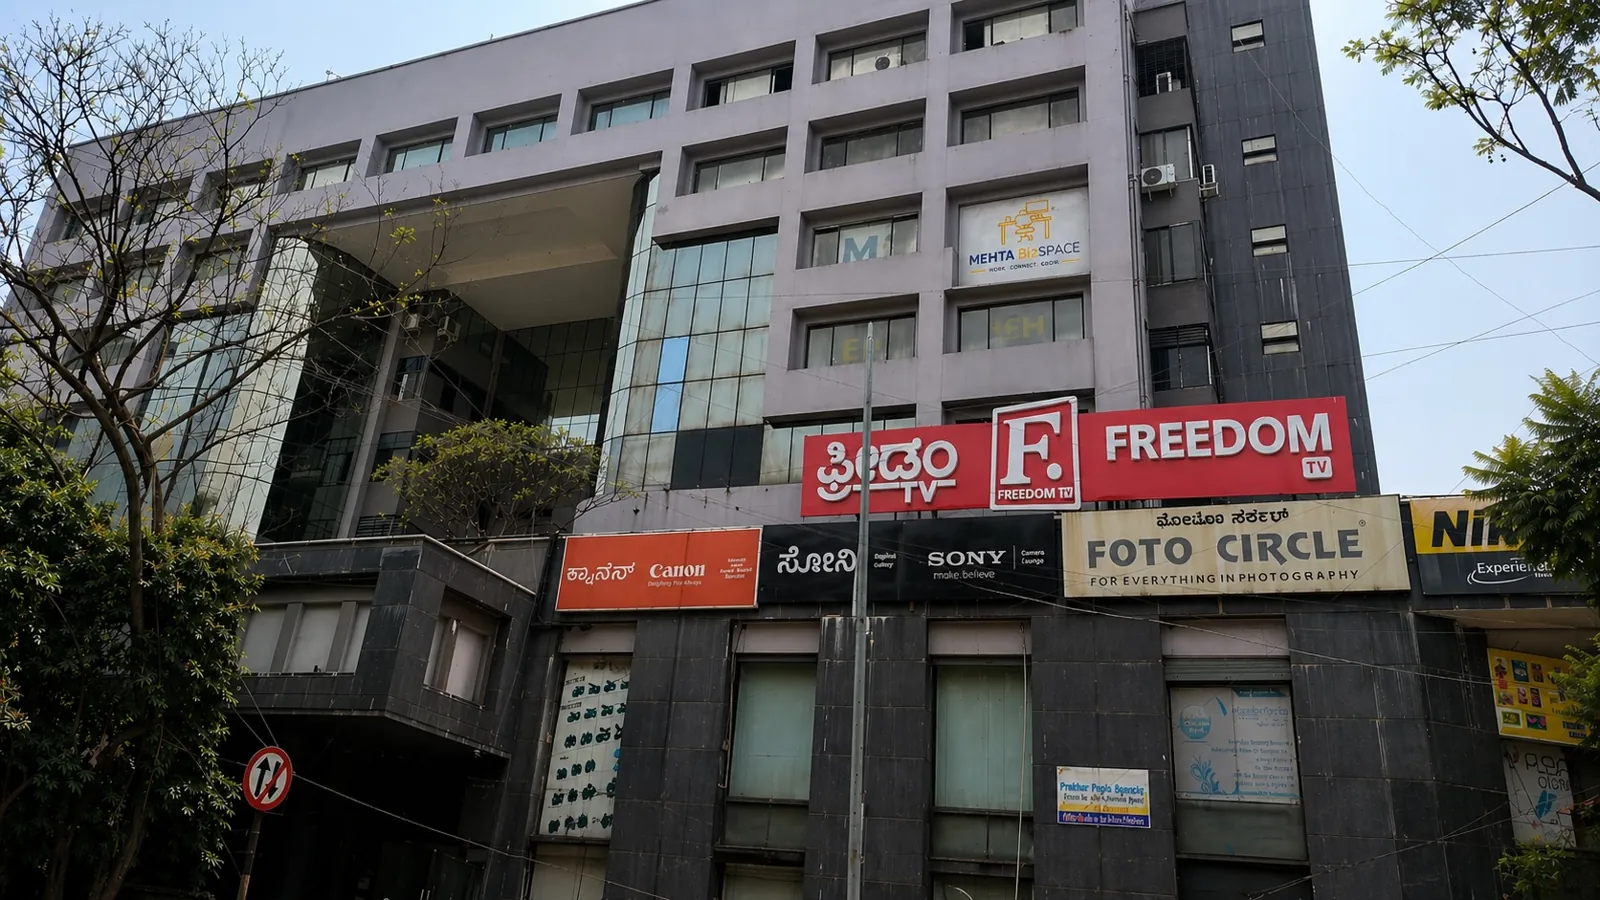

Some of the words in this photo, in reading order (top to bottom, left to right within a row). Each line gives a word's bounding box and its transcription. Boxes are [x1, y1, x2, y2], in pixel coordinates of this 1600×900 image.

[969, 250, 1015, 266] MEHTA
[1105, 412, 1333, 461] FREEDOM
[1306, 460, 1328, 474] TV
[998, 487, 1056, 500] FREEDOM
[1058, 486, 1073, 499] TV
[1087, 536, 1193, 568] FOTO
[1216, 529, 1363, 565] CIRCLE
[777, 545, 857, 574] ಸೋನಿ
[927, 550, 1007, 567] SONY
[649, 563, 706, 578] Canon
[1090, 576, 1118, 587] FOR
[1123, 574, 1216, 586] EVERYTHING
[1220, 574, 1235, 583] IN
[1238, 569, 1359, 583] PHOTOGRAPHY
